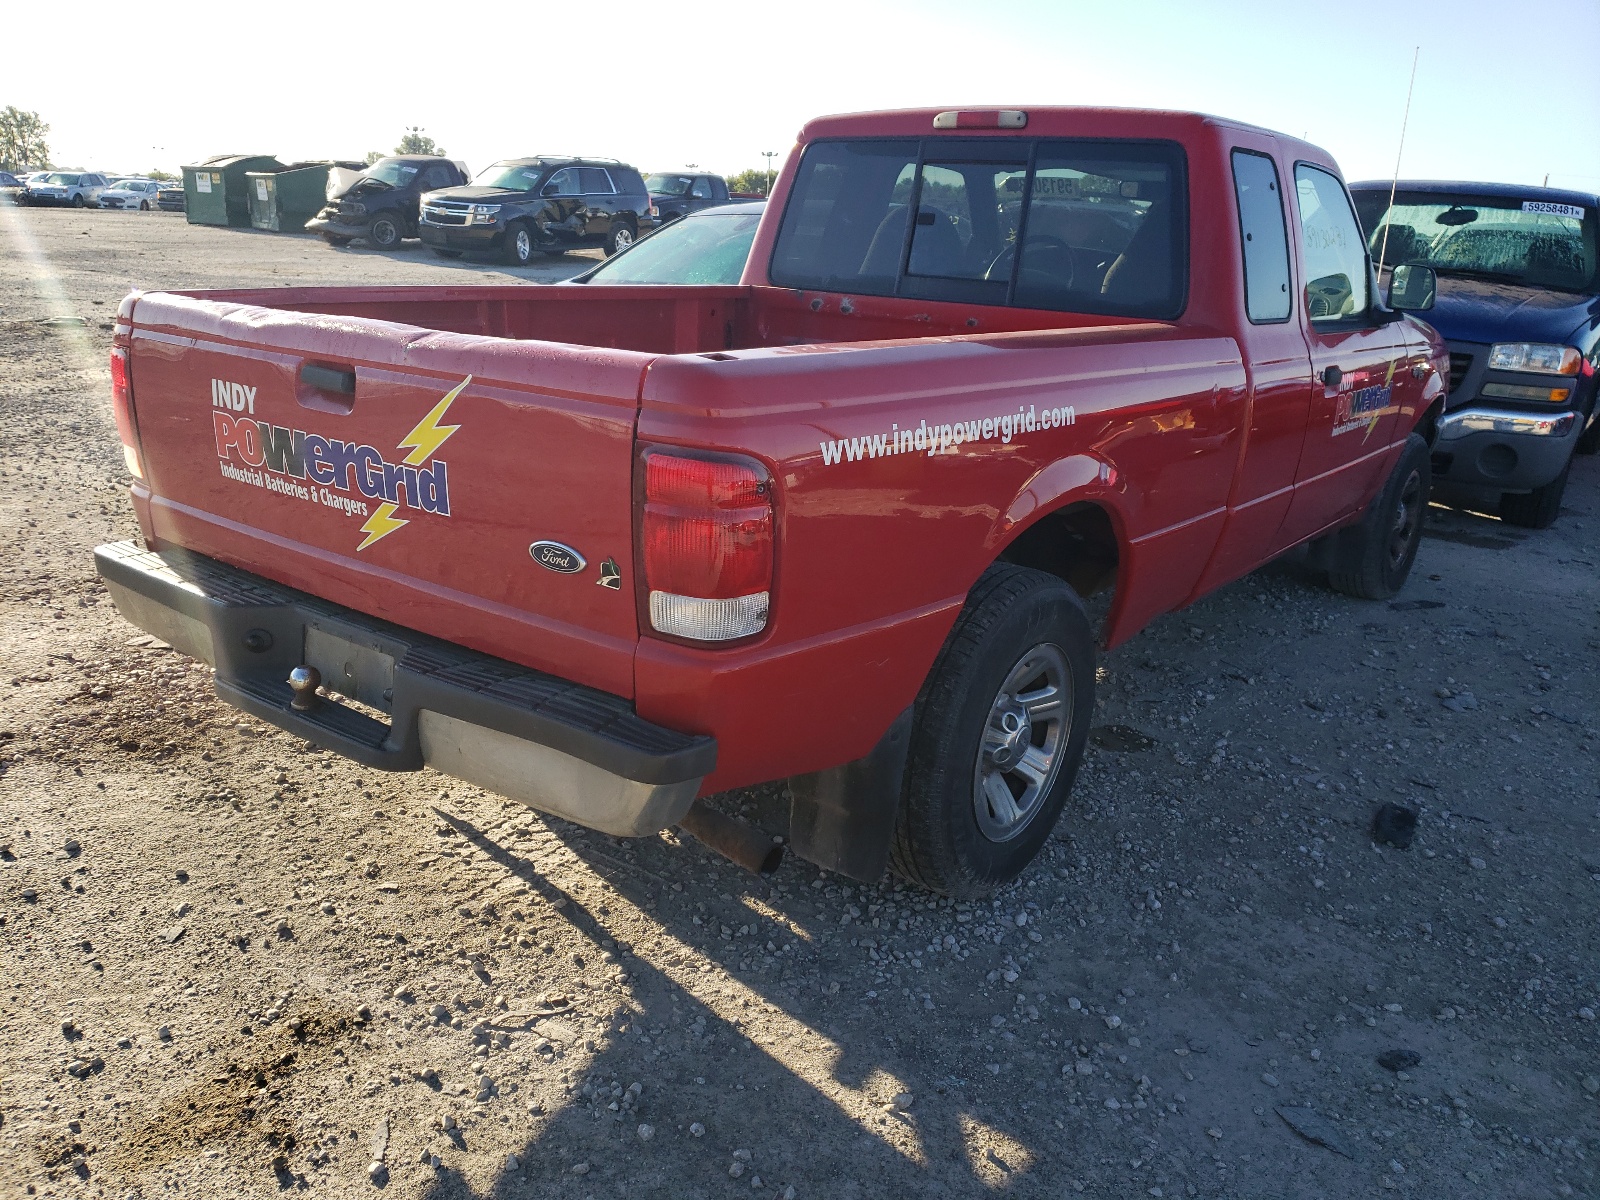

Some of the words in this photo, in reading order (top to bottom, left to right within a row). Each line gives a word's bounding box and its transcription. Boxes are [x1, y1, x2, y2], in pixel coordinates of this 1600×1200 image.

[211, 378, 257, 414] INDY
[819, 404, 1076, 466] www.indypowergrid.com
[220, 460, 264, 488] Industrial
[264, 473, 309, 501] Batteries
[311, 485, 318, 503] &
[319, 488, 368, 517] Chargers
[541, 547, 570, 568] Ford
